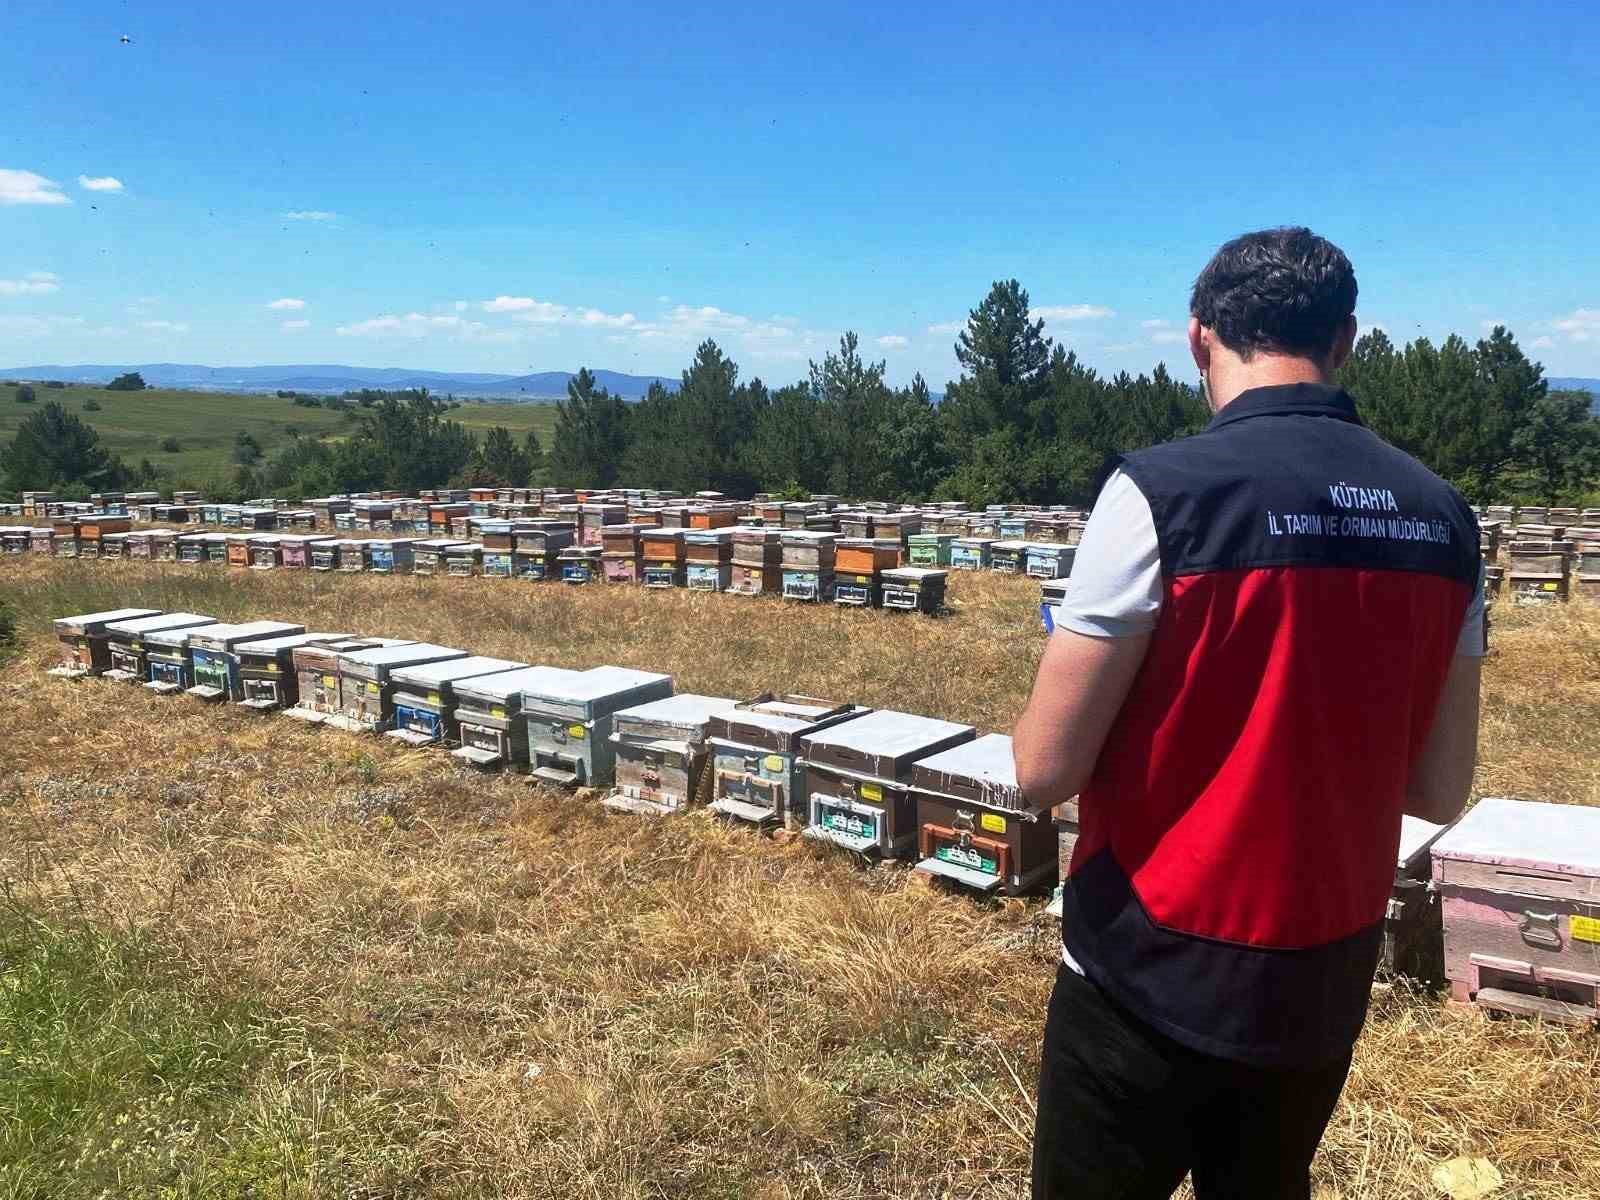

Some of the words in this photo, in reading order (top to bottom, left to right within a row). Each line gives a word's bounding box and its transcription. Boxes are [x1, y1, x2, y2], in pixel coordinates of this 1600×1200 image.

[1329, 481, 1399, 512] KÜTAHYA
[1268, 511, 1283, 535] İL
[1283, 514, 1322, 535] TARIM
[1323, 515, 1338, 536] VE
[1341, 516, 1386, 538] ORMAN
[1388, 516, 1450, 544] MÜDÜRLÜĞÜ
